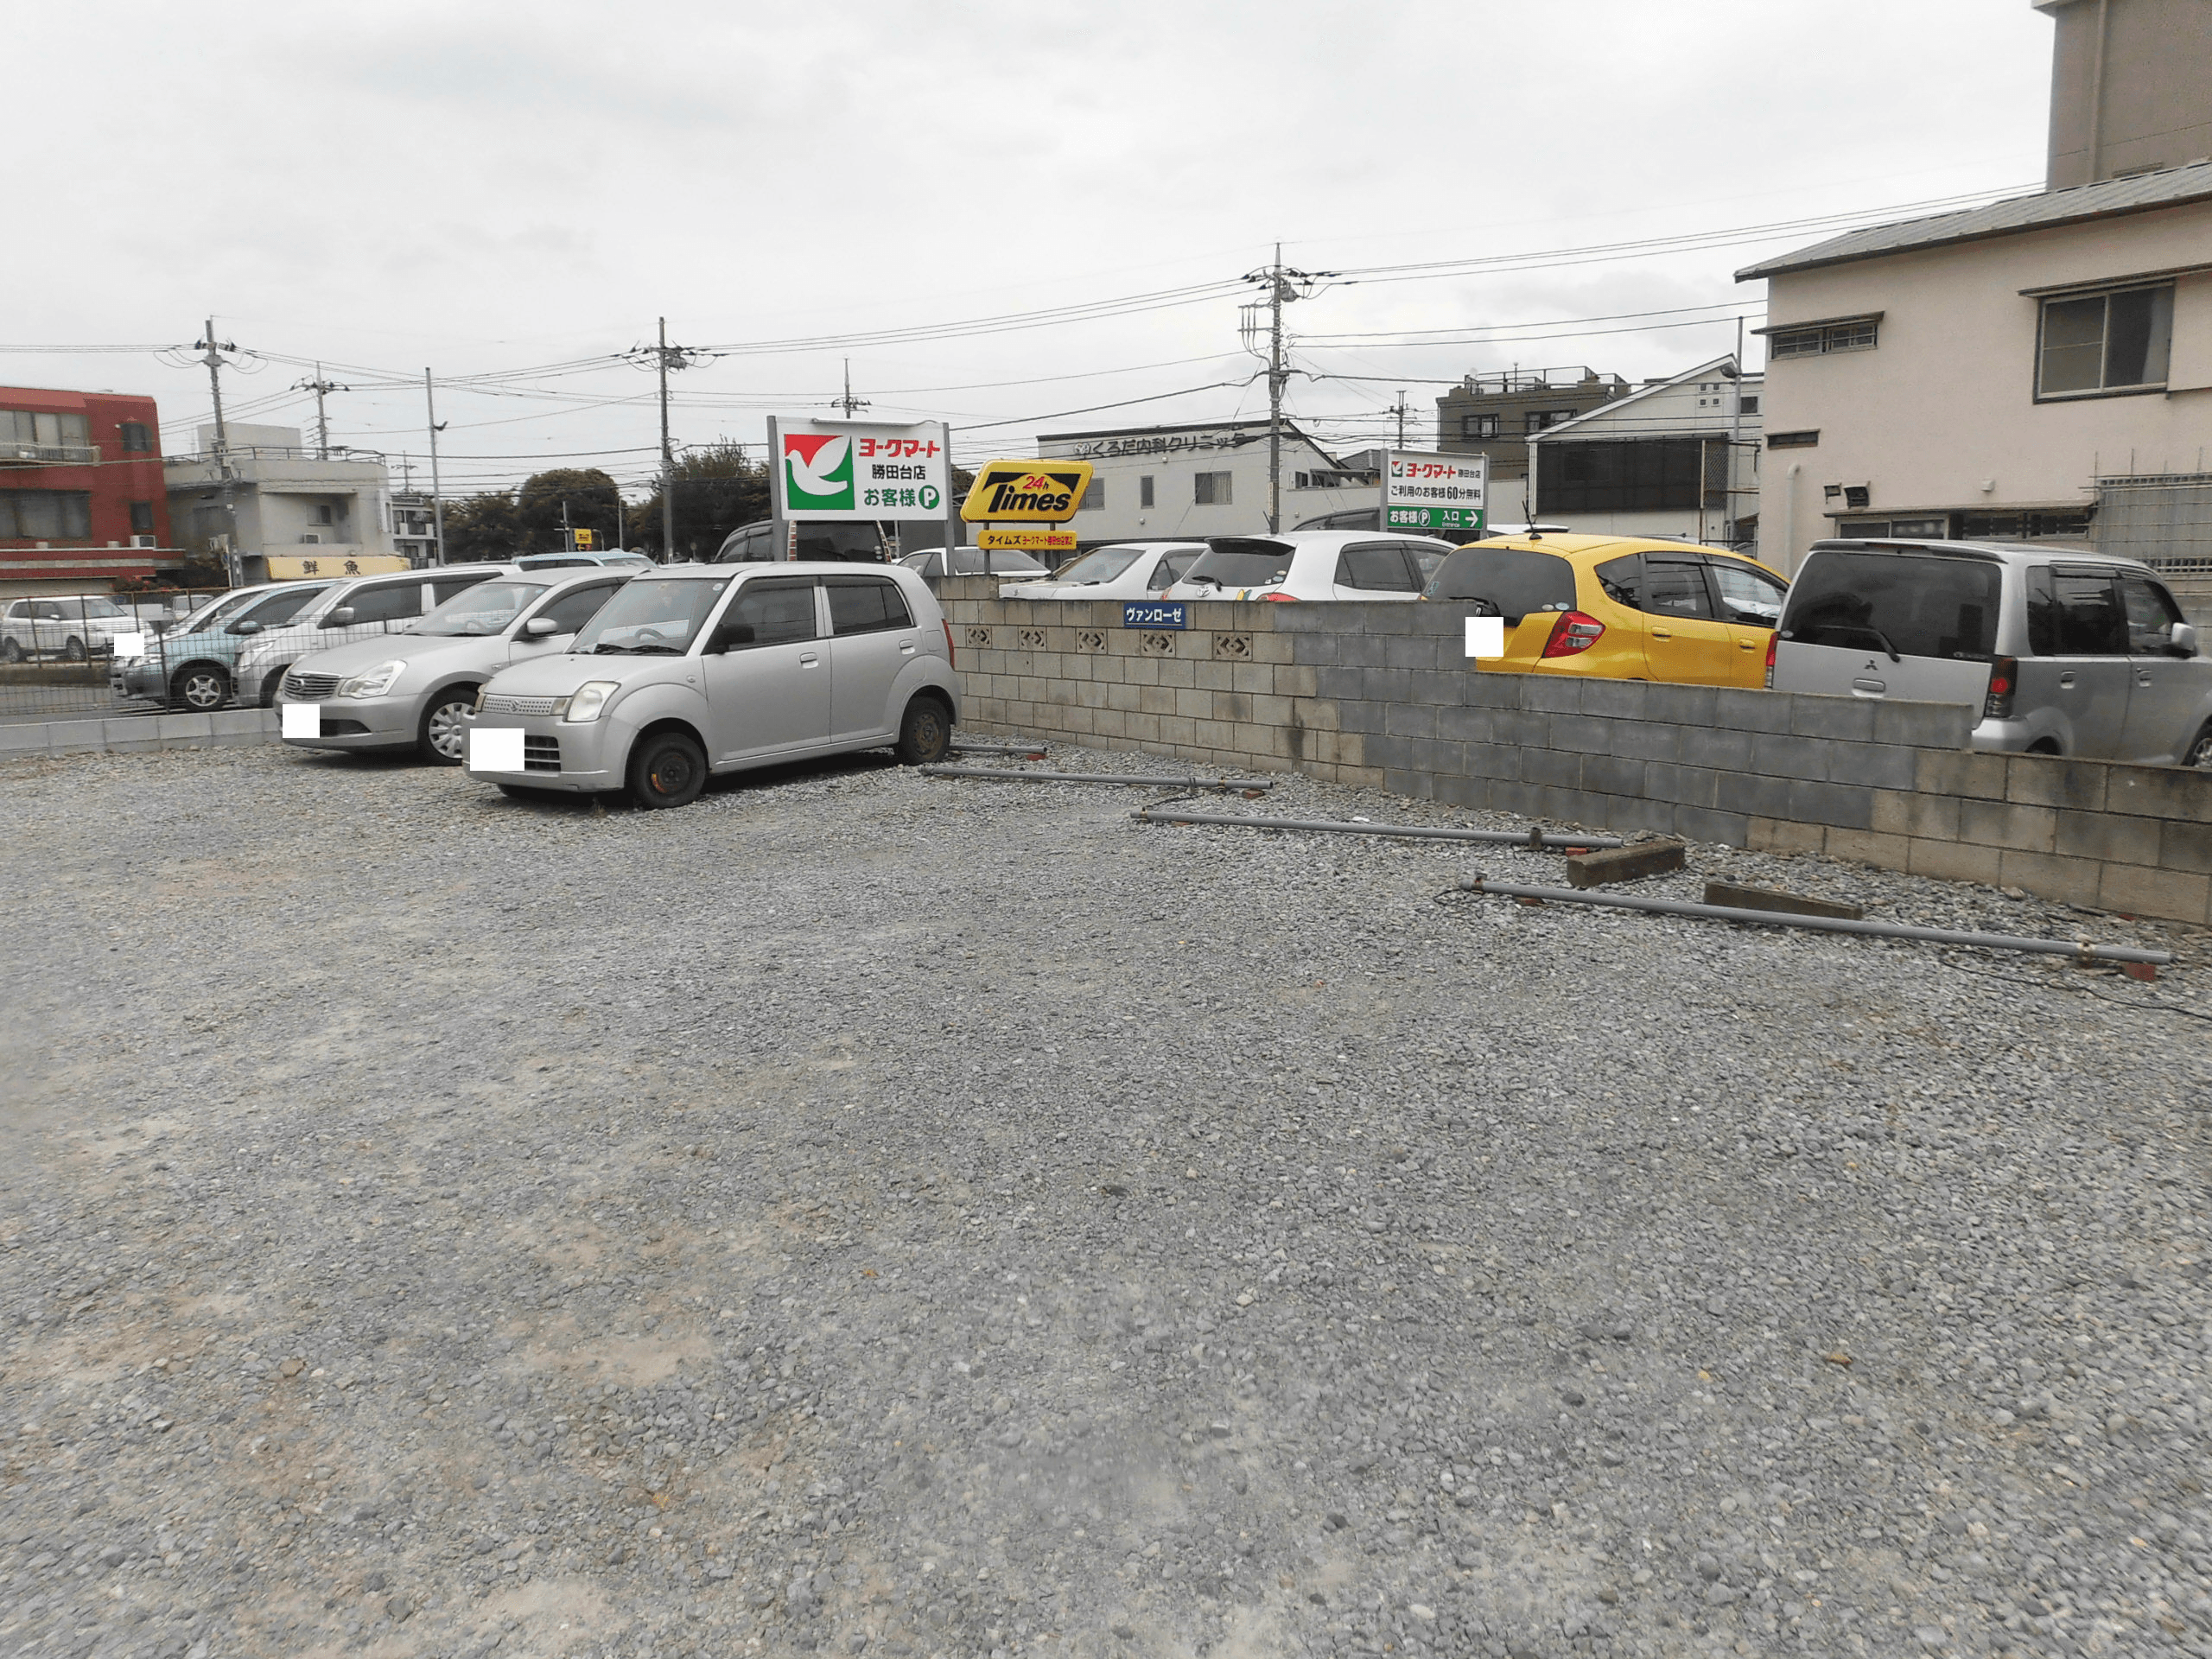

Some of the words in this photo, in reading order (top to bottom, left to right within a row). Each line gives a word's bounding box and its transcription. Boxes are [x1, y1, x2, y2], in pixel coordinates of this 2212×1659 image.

[859, 438, 941, 458] ヨークマート
[872, 464, 926, 480] 勝田台店
[1406, 462, 1457, 479] ヨークマート
[988, 484, 1071, 512] Times
[1391, 485, 1481, 500] ご利用のお客様60分無料
[1442, 511, 1459, 521] 入口
[1126, 607, 1182, 622] ヴァンローゼ
